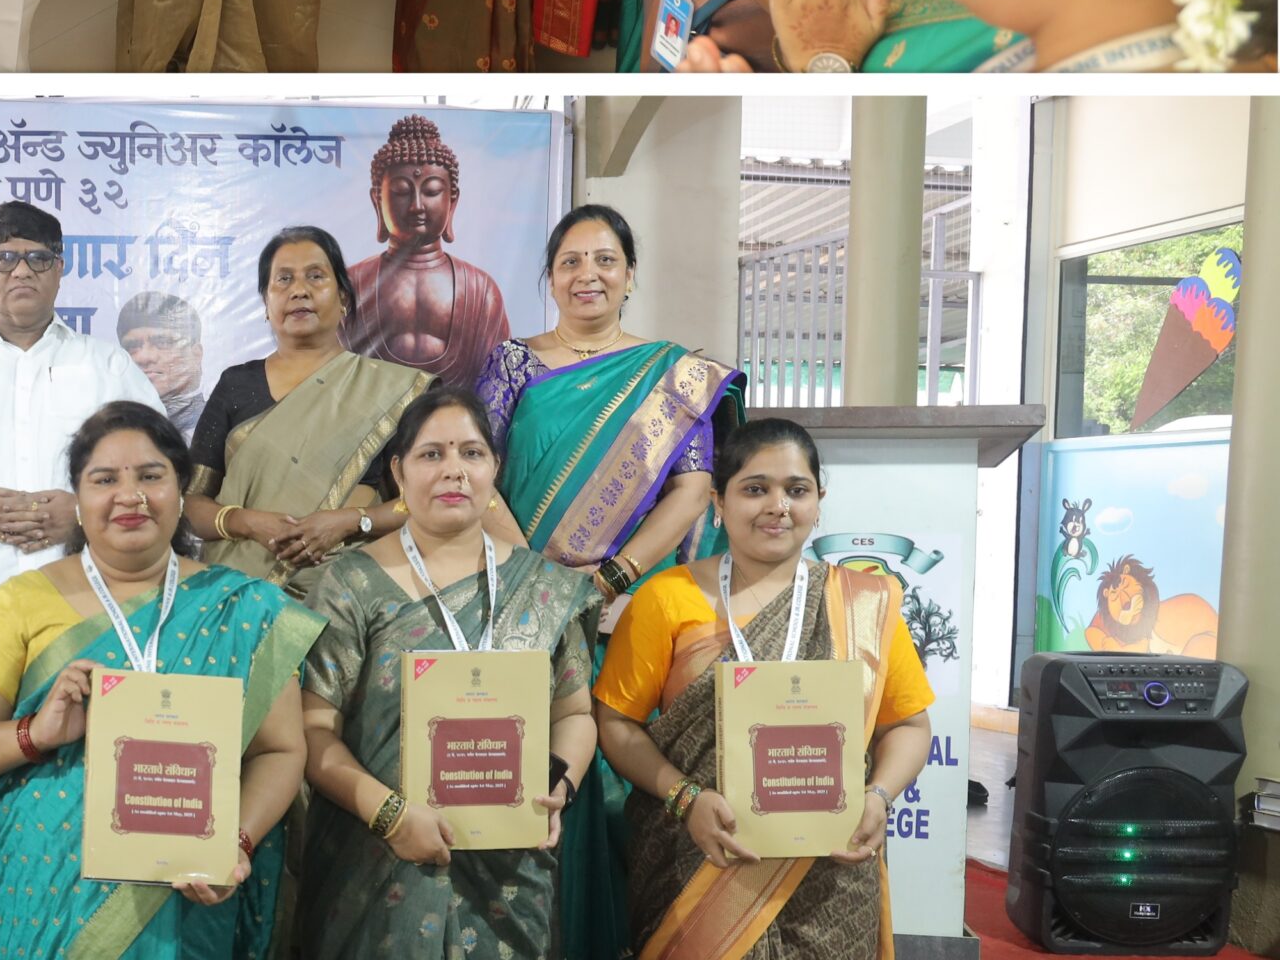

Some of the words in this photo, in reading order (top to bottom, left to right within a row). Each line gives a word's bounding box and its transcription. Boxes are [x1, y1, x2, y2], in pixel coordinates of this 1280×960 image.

[76, 120, 223, 175] ज्युनिअर
[234, 122, 346, 169] कॉलेज
[78, 176, 130, 215] ३२
[851, 538, 875, 546] CES
[440, 770, 484, 781] Constitution
[485, 770, 493, 780] of
[494, 769, 513, 780] India
[762, 776, 806, 788] Constitution
[807, 776, 814, 786] of
[815, 775, 835, 786] India
[125, 794, 173, 807] Constitution
[173, 797, 182, 808] of
[182, 798, 203, 809] India
